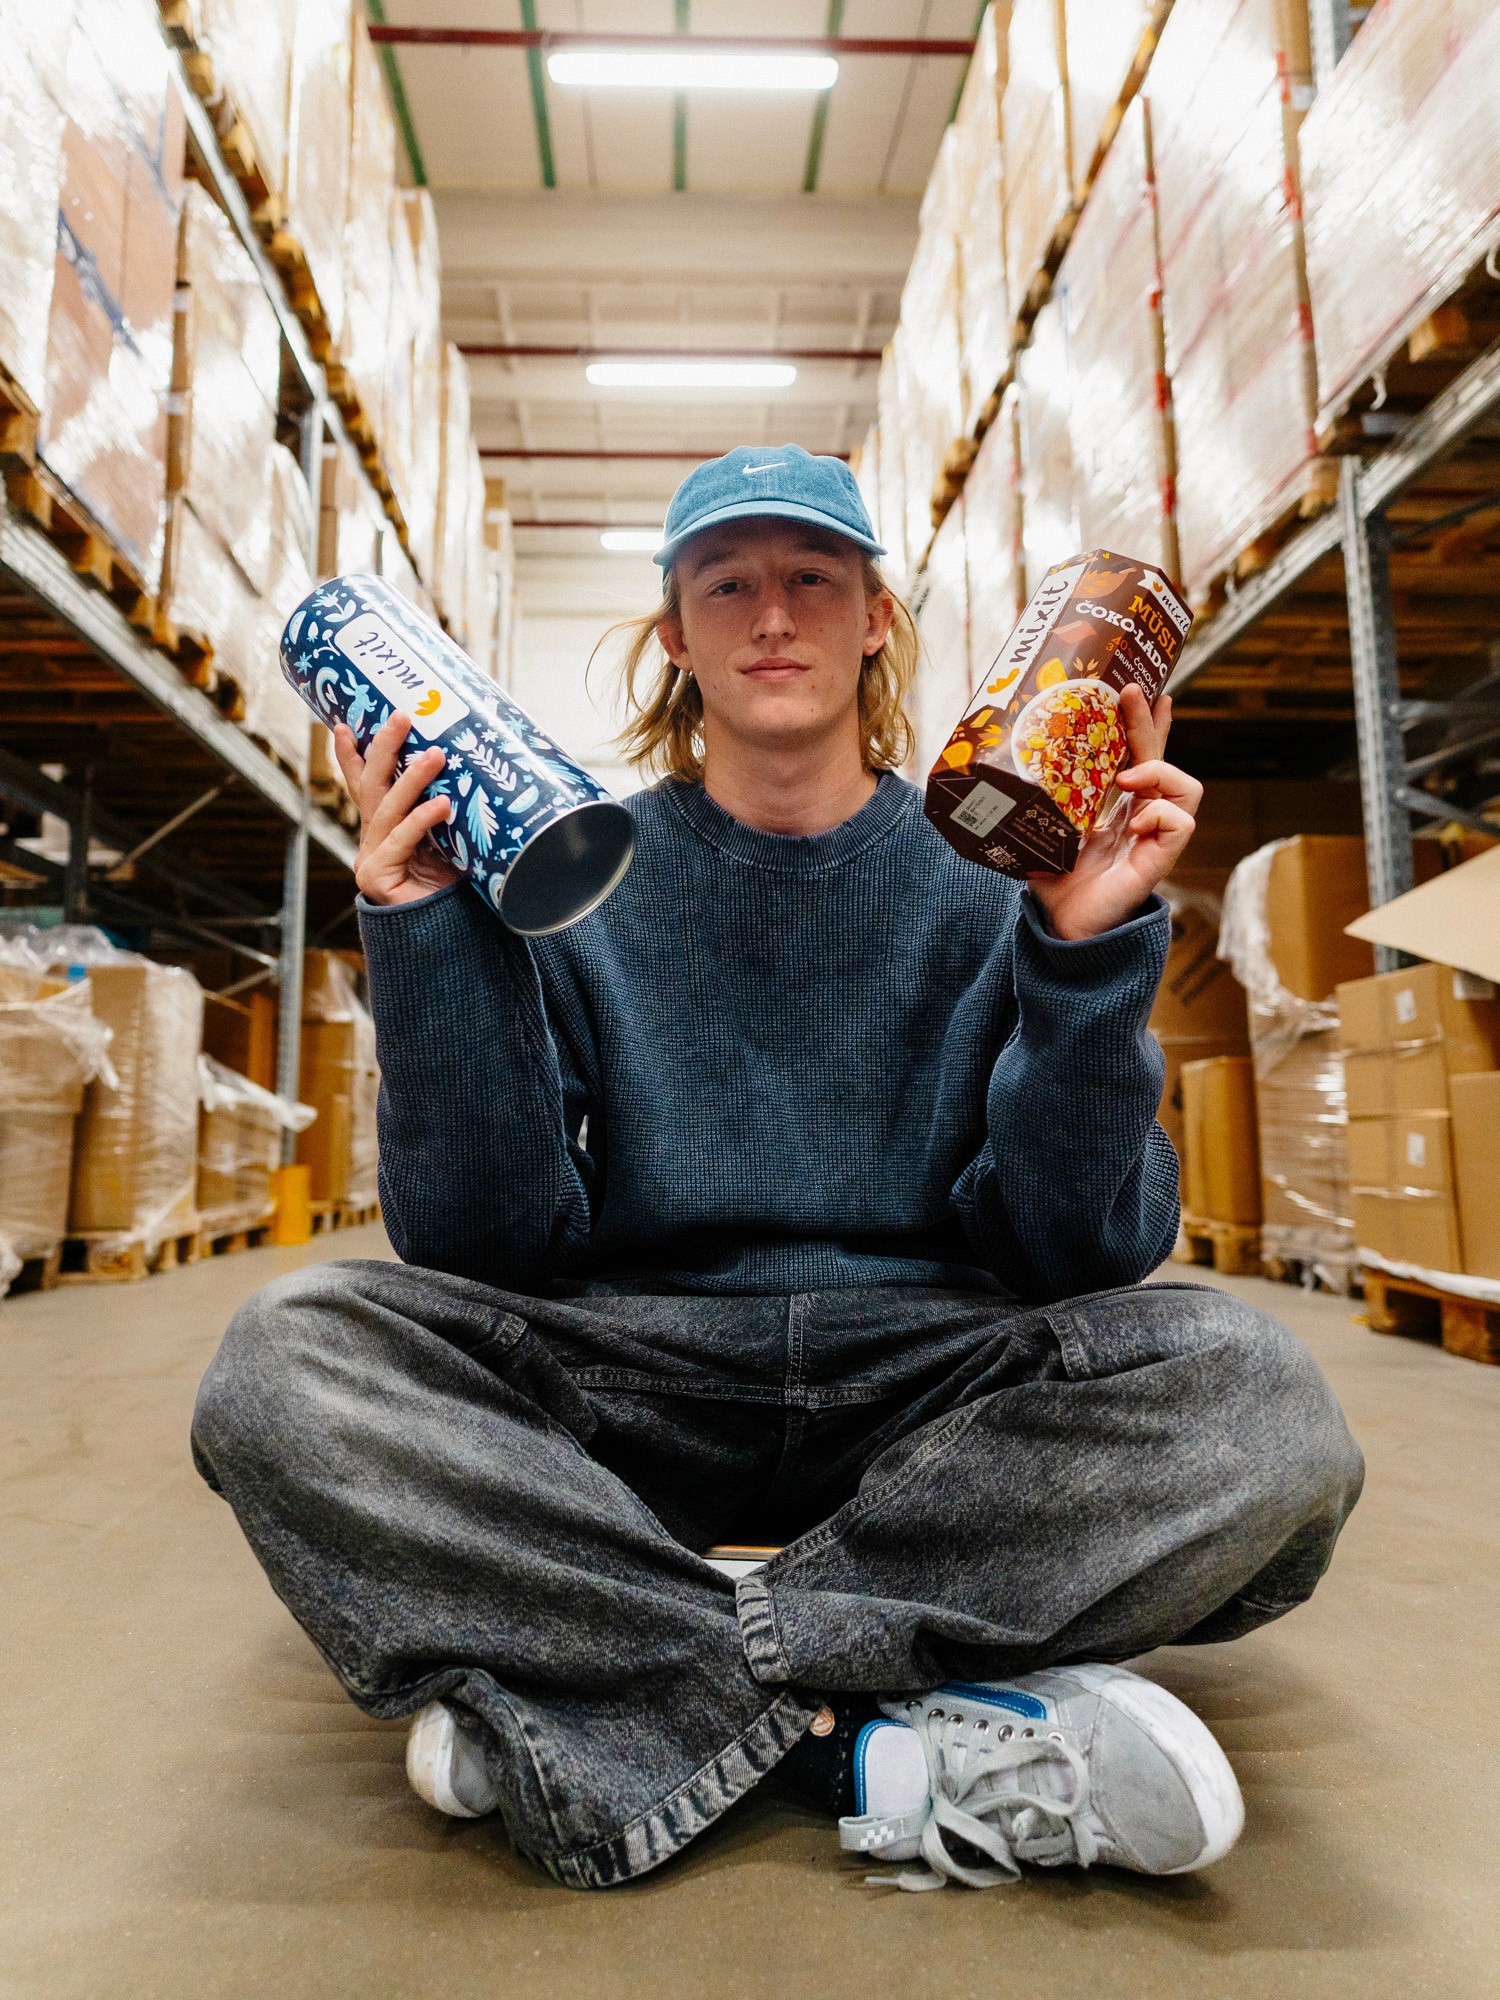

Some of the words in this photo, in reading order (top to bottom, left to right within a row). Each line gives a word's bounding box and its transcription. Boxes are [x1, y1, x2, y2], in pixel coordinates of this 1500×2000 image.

[1009, 580, 1069, 664] mixit
[1161, 595, 1190, 633] mixit
[353, 630, 425, 691] mixit
[1114, 648, 1135, 672] DRUHY
